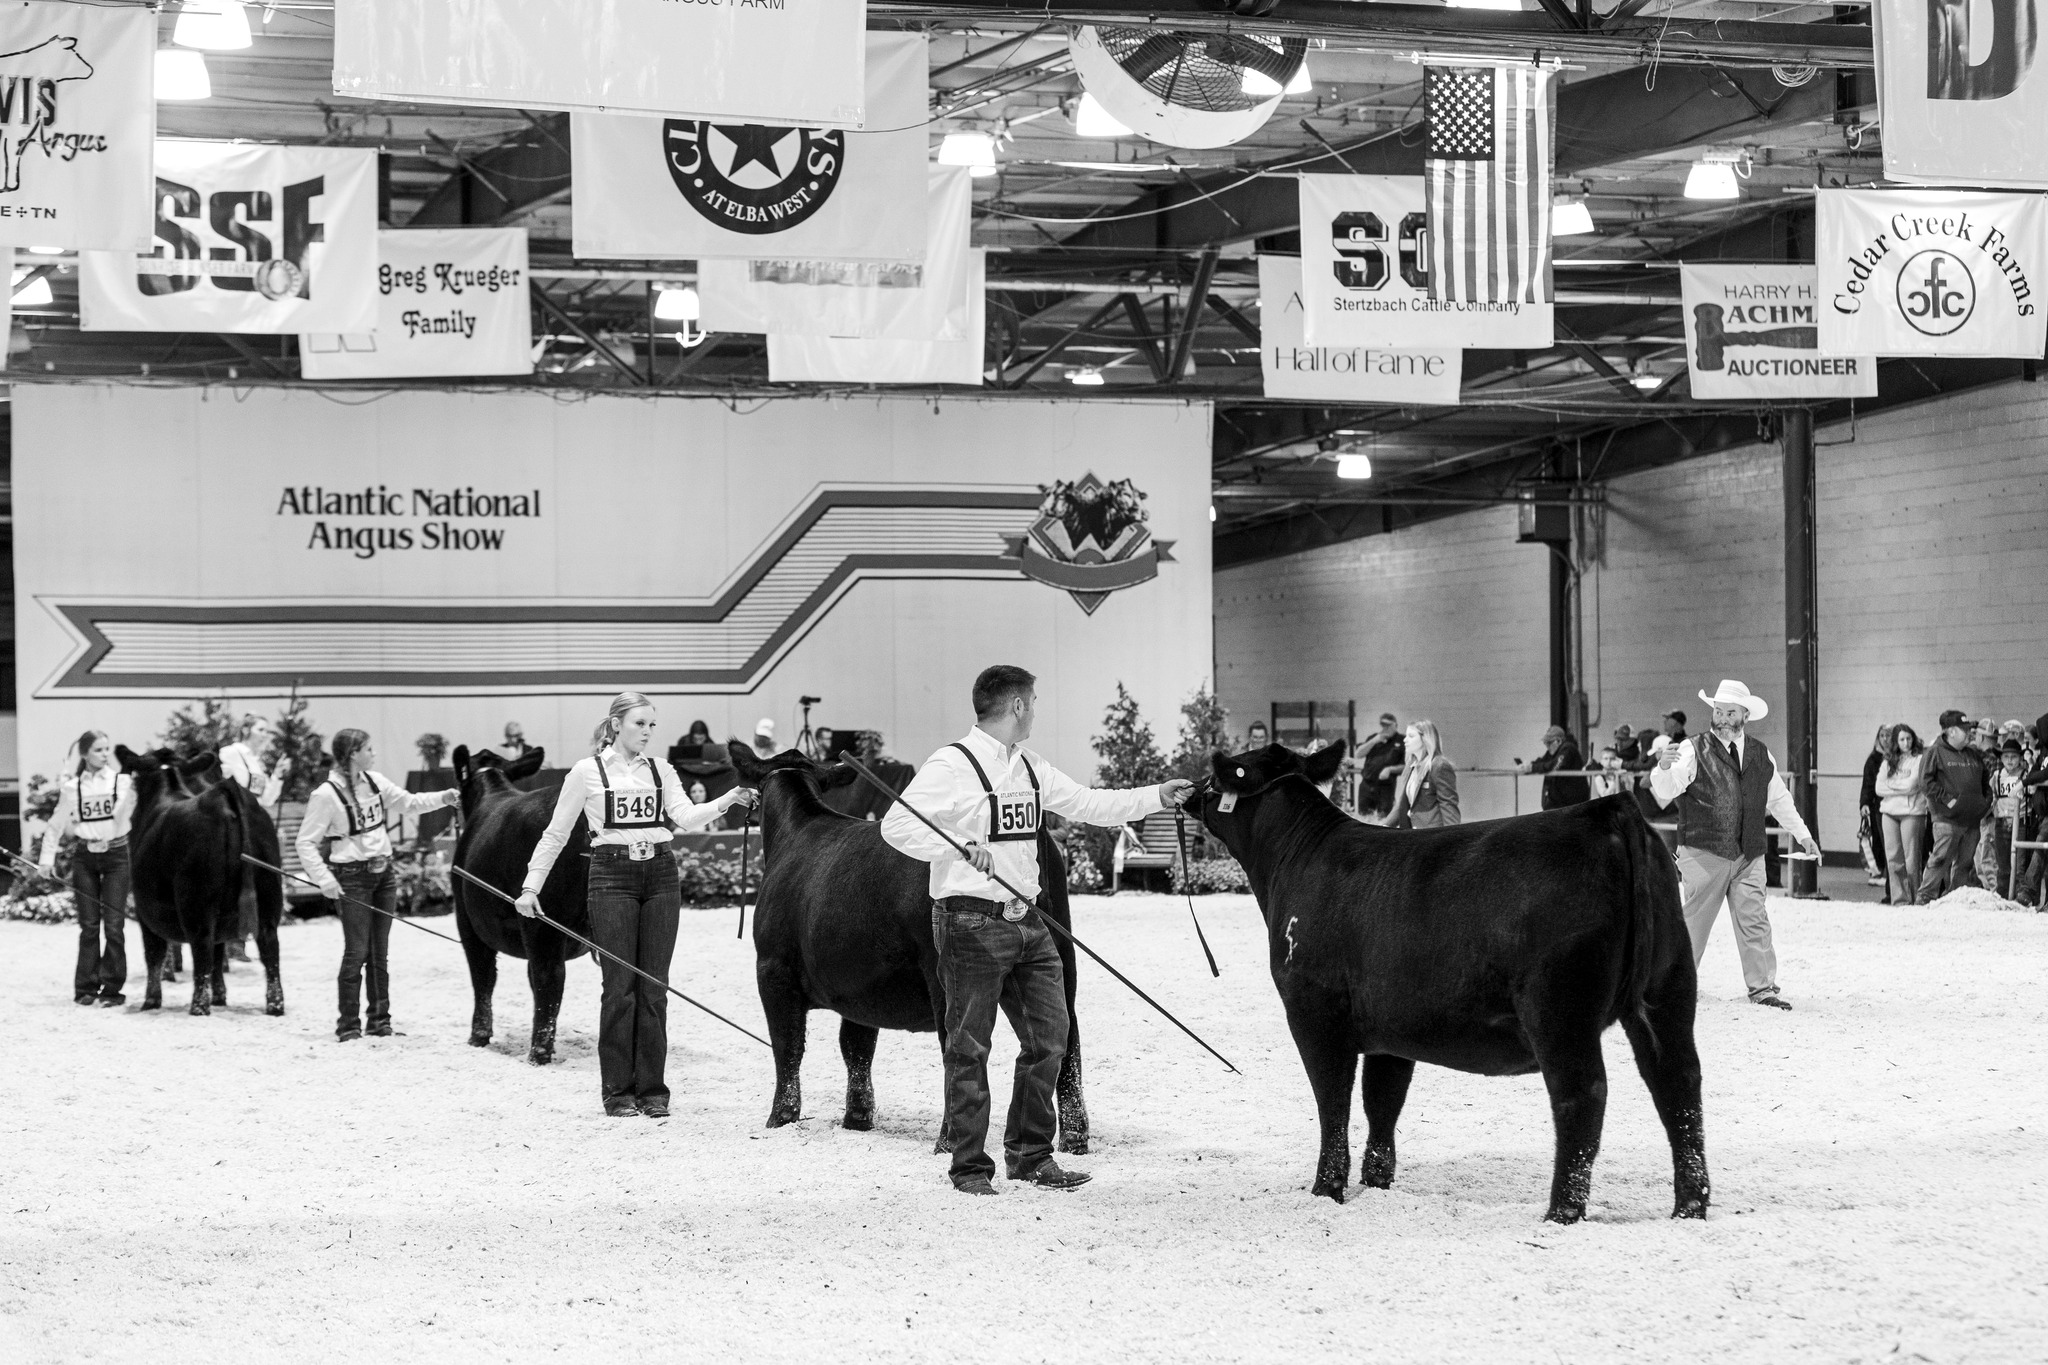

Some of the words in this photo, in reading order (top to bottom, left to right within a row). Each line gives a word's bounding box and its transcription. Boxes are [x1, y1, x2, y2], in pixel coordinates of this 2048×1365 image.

[31, 207, 57, 219] TN
[702, 189, 728, 210] AT
[724, 200, 769, 222] ELBA
[768, 187, 812, 220] WEST
[378, 263, 427, 295] Greg
[433, 263, 520, 295] Krueger
[1833, 232, 1891, 315] Cedar
[1891, 212, 1975, 242] Creek
[1978, 225, 2036, 317] Farms
[1334, 297, 1407, 311] Stertzbach
[1411, 297, 1451, 312] Cattle
[1724, 285, 1791, 299] HARRY
[401, 310, 477, 339] Family
[1727, 305, 1818, 323] ACHM
[1275, 347, 1327, 372] Hall
[1332, 347, 1361, 374] of
[1365, 349, 1445, 377] Fame
[1727, 359, 1858, 376] AUCTIONEER
[277, 485, 404, 516] Atlantic
[412, 486, 541, 517] National
[308, 522, 413, 559] Angus
[421, 522, 505, 550] Show
[83, 800, 112, 817] 546
[616, 796, 655, 819] 548
[1002, 801, 1035, 830] 550
